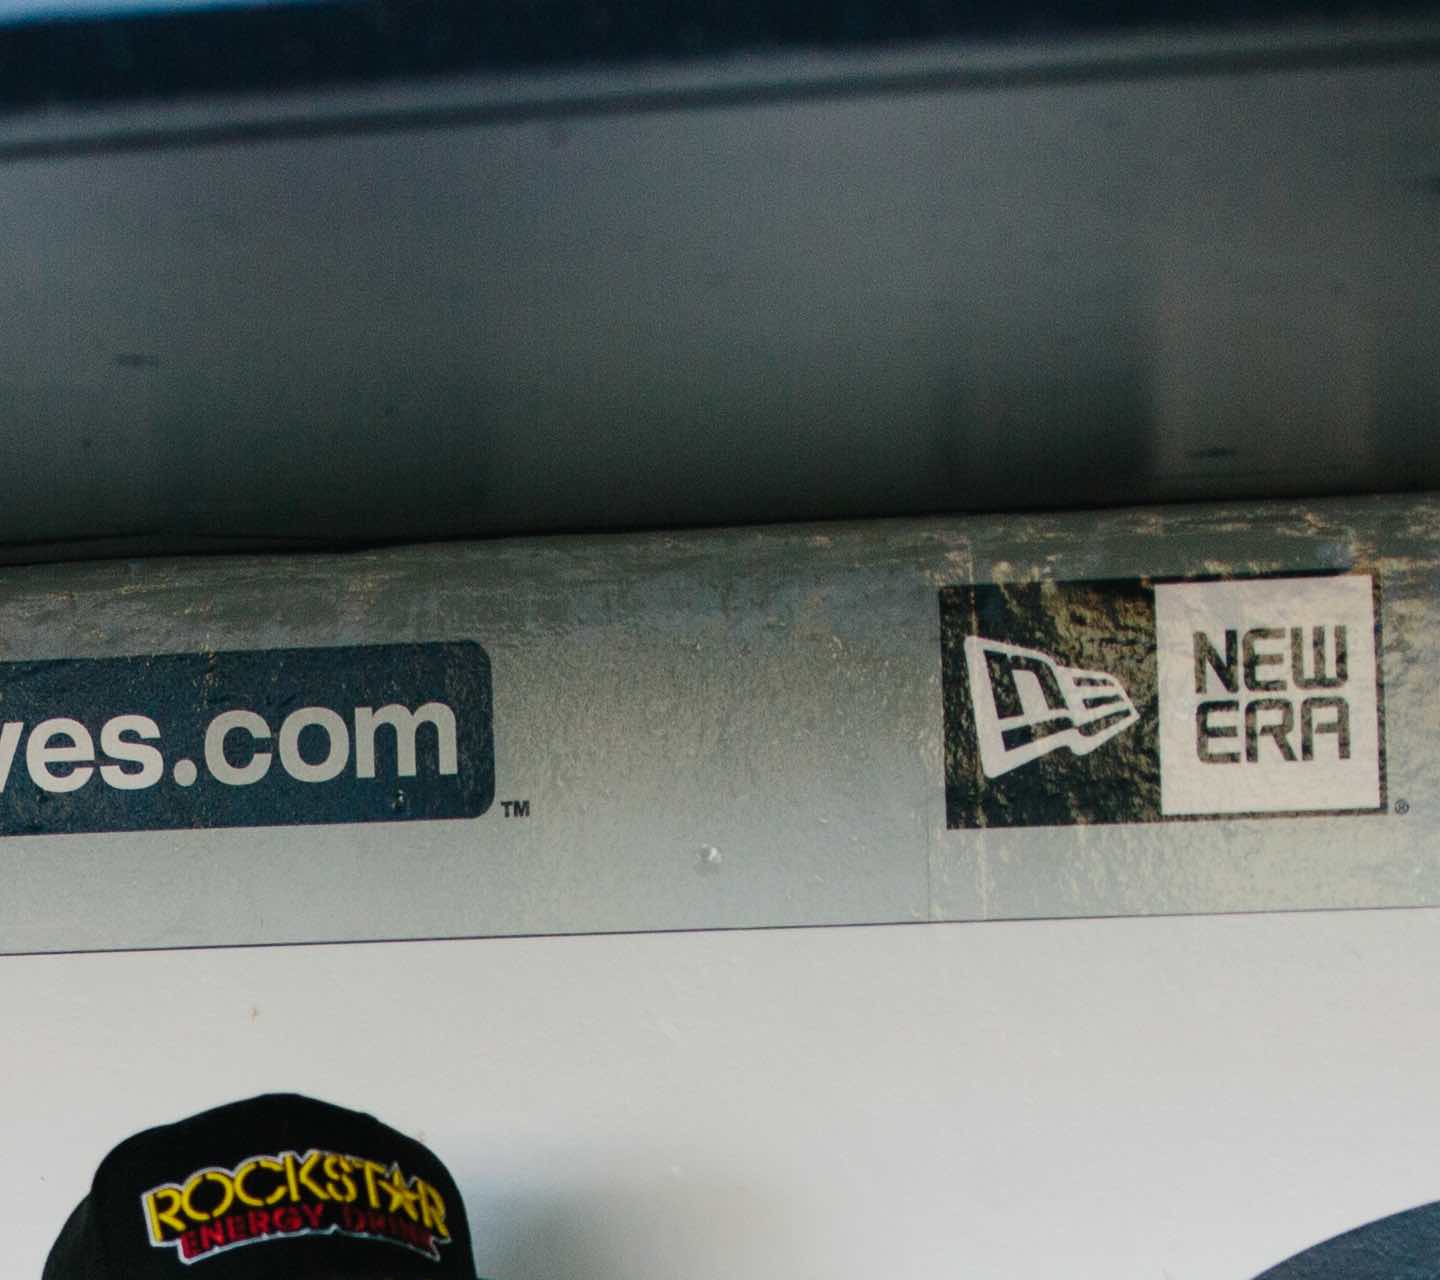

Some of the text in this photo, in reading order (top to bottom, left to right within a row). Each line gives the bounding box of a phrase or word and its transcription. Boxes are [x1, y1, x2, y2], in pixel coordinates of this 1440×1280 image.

[1193, 625, 1349, 692] NEW
[1195, 694, 1351, 764] ERA
[500, 799, 531, 819] TM
[180, 1203, 324, 1259] ENERGY
